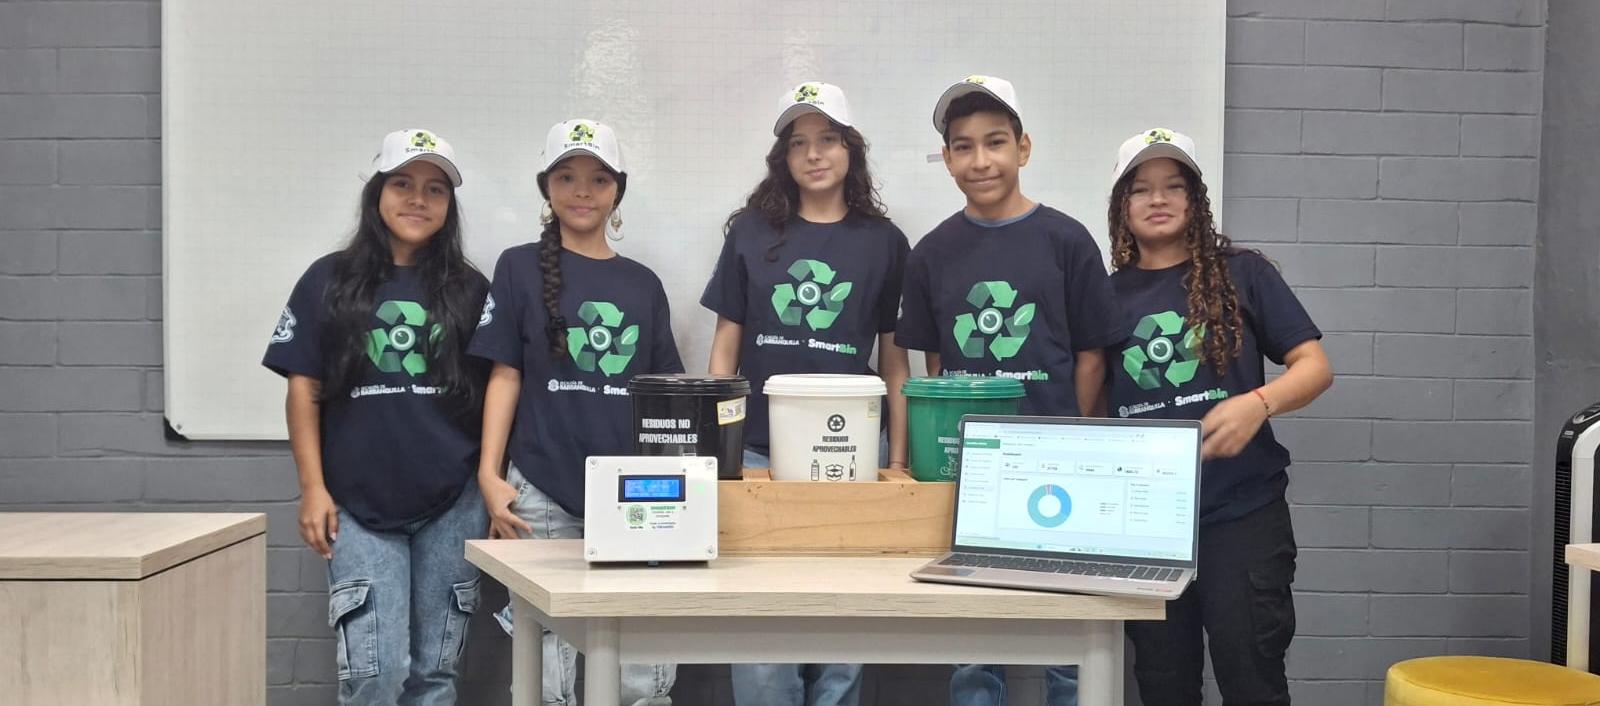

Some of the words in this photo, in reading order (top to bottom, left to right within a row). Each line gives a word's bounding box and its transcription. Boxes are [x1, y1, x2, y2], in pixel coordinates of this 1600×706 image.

[807, 338, 857, 355] SmartBin
[995, 369, 1049, 381] SmartBin
[1174, 388, 1228, 406] SmartBin
[642, 418, 677, 429] RESIDUOS
[678, 418, 691, 429] NO
[639, 433, 698, 444] APROVECHABLES
